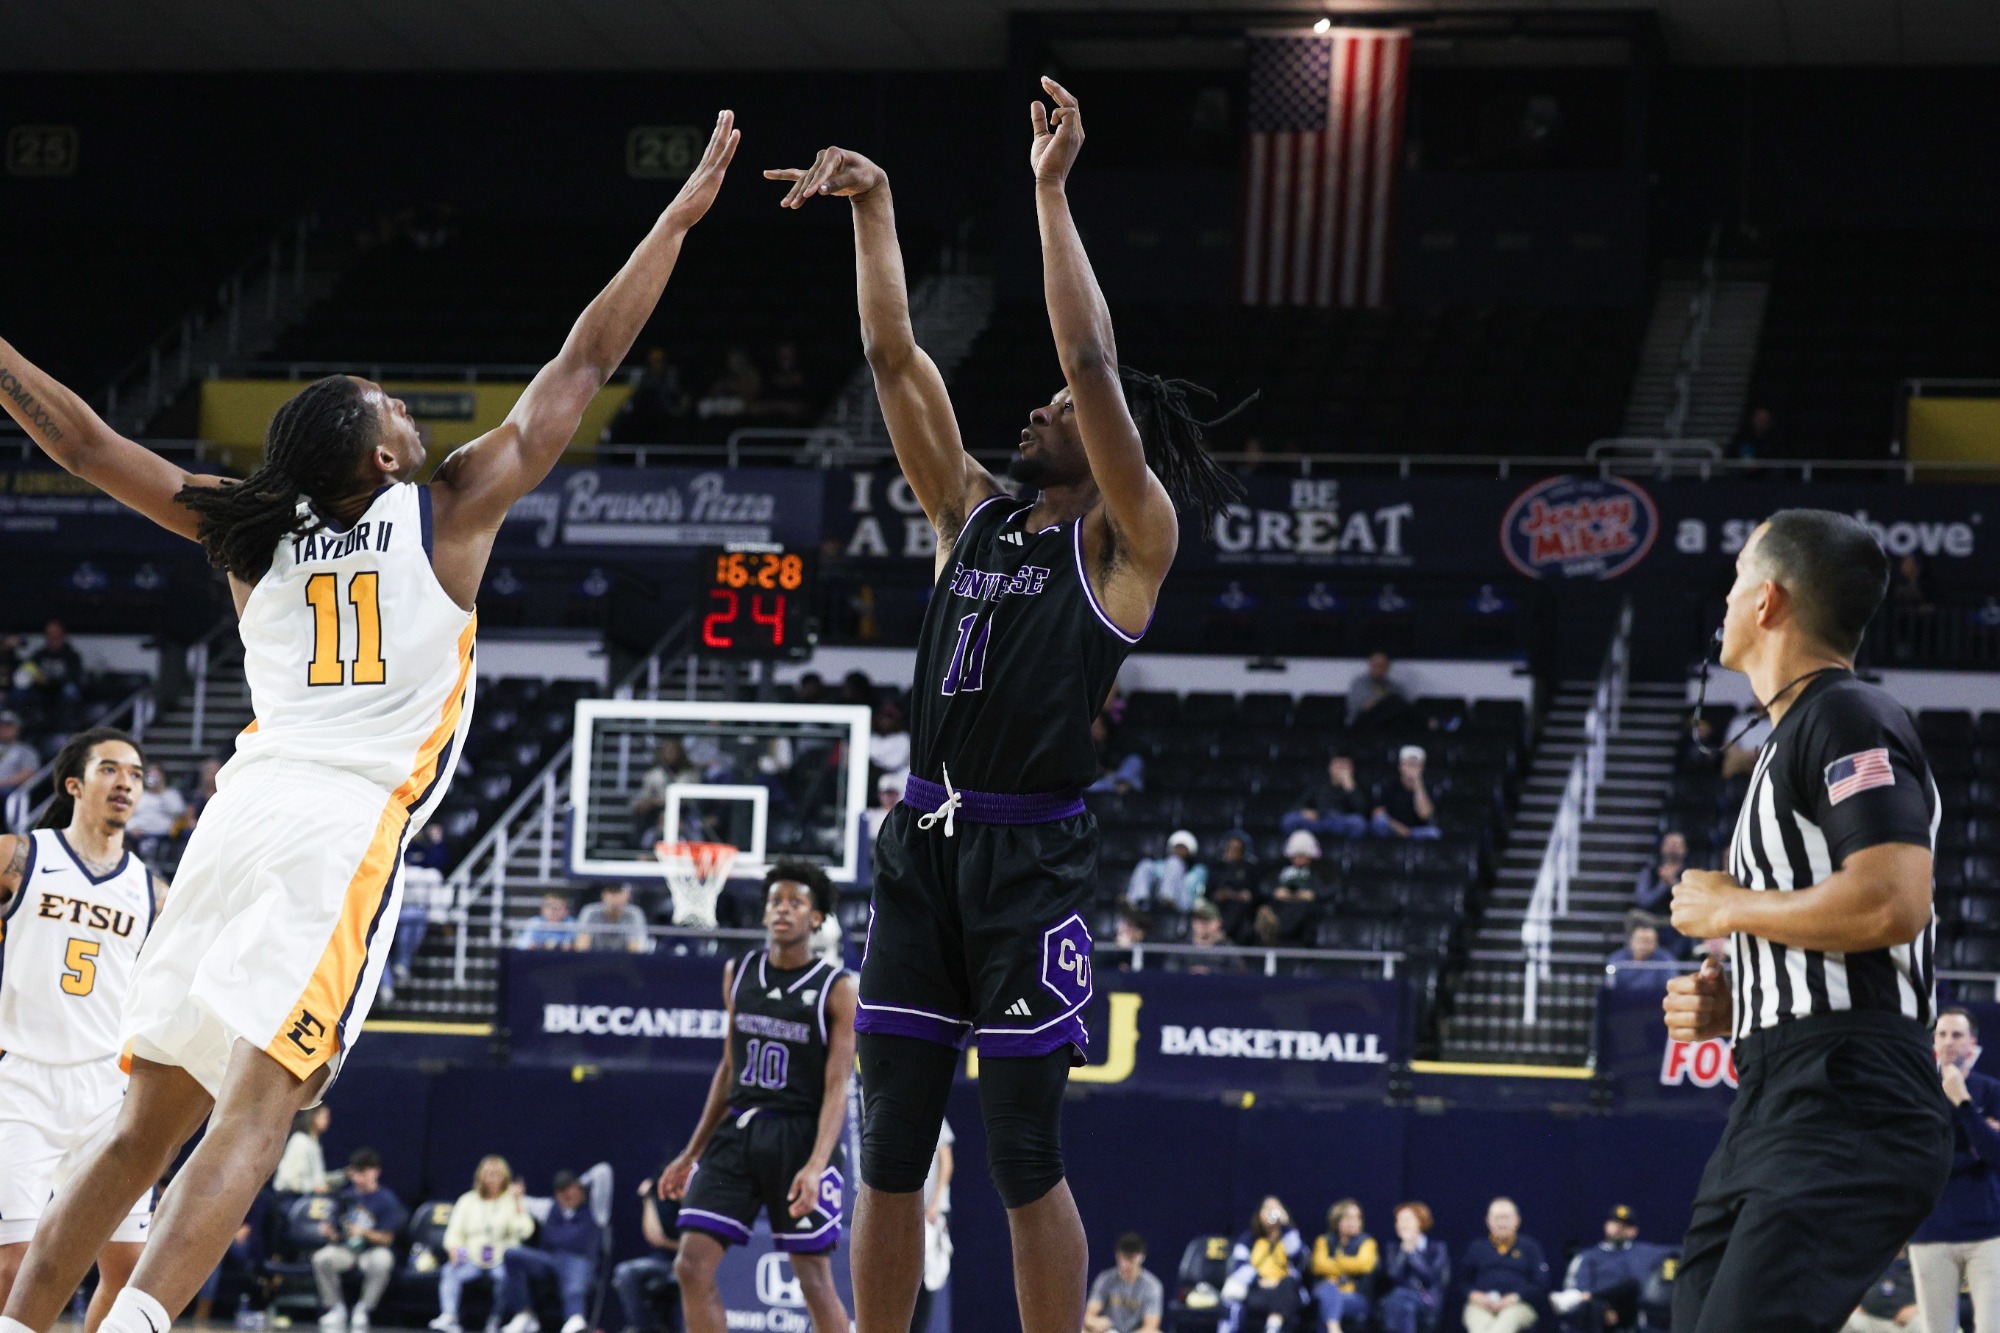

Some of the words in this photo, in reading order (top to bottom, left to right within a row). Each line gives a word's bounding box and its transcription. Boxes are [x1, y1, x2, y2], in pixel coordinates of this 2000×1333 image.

[640, 136, 690, 168] 26
[690, 472, 775, 523] Pizza
[1290, 479, 1340, 510] BE
[292, 521, 371, 565] TAYLOR
[376, 521, 393, 552] II
[846, 515, 889, 558] A
[1213, 502, 1415, 554] GREAT
[1674, 518, 1708, 554] a
[716, 552, 803, 591] 16:28
[305, 571, 386, 687] 11
[703, 589, 787, 649] 24
[941, 612, 993, 696] 11
[38, 893, 135, 938] ETSU
[60, 938, 100, 996] 5
[1058, 938, 1087, 987] CU
[740, 1039, 790, 1090] 10
[1160, 1024, 1389, 1064] BASKETBALL
